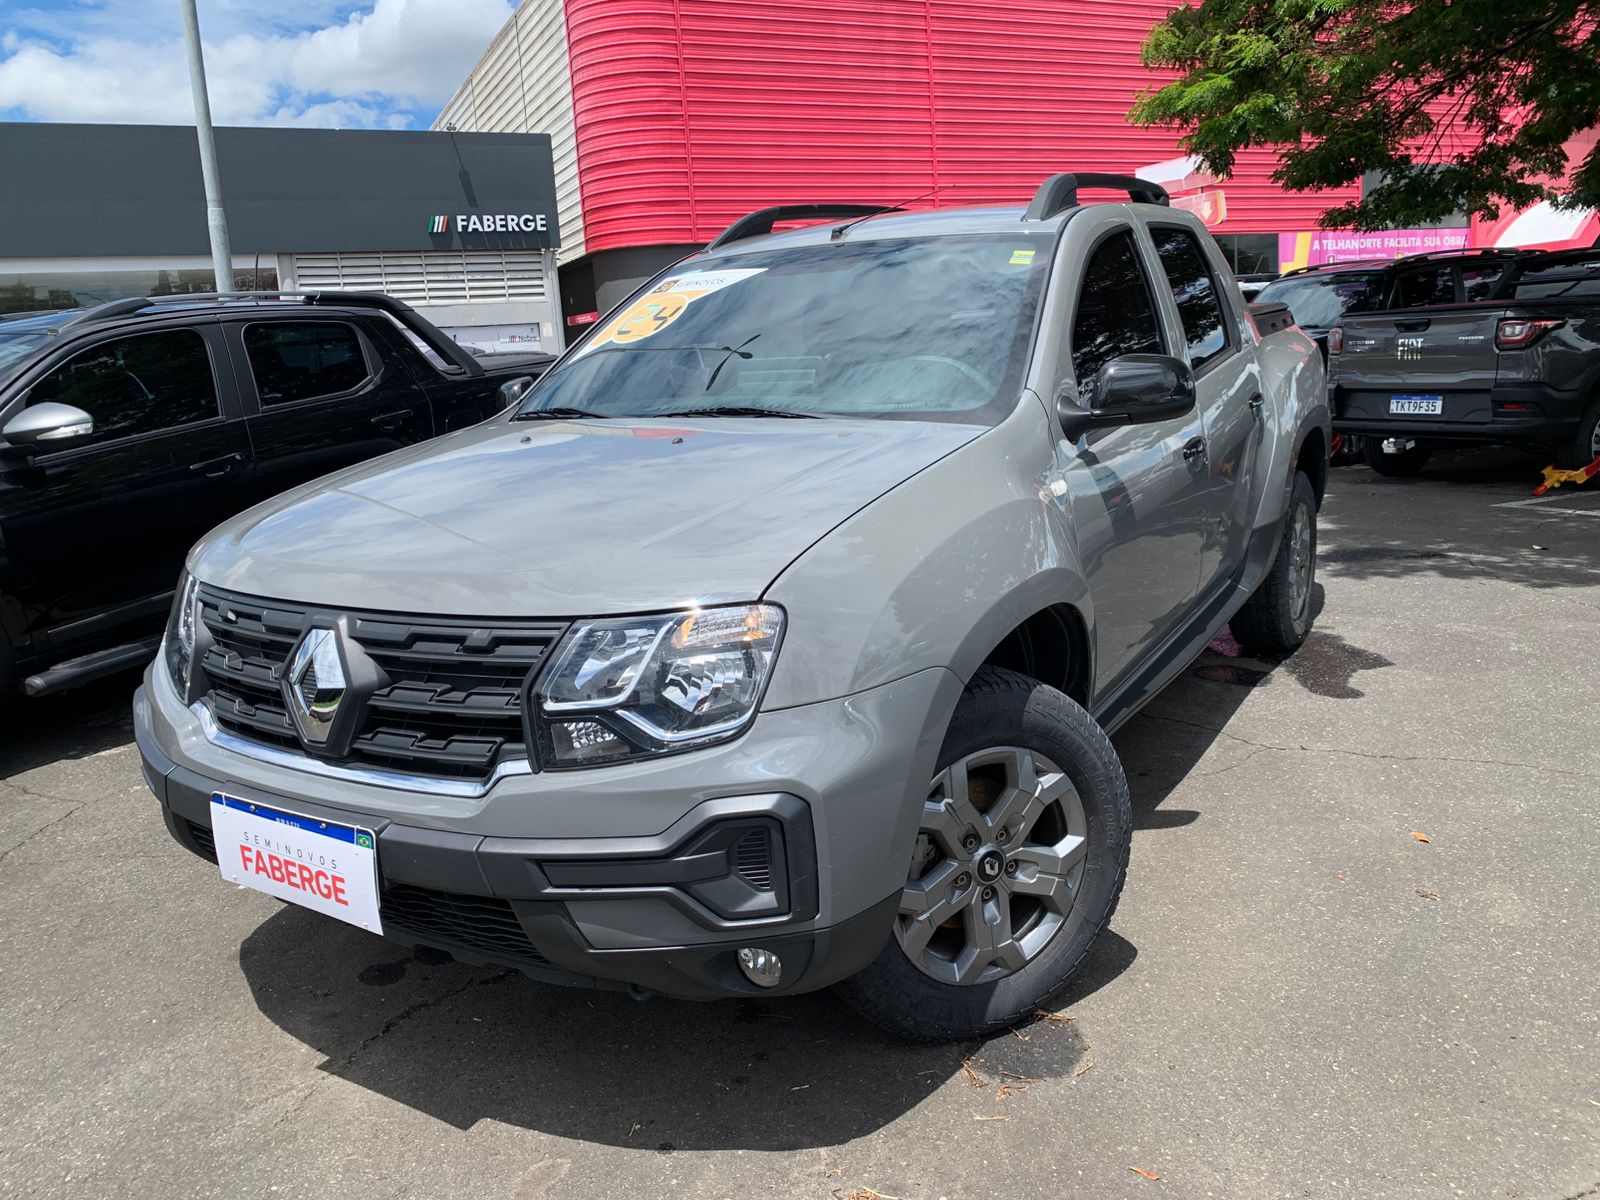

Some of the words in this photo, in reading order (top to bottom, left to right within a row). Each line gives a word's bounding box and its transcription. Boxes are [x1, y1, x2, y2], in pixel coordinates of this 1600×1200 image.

[456, 214, 547, 232] FABERGE
[1313, 240, 1320, 250] A
[1322, 238, 1382, 250] TELHANORTE
[1384, 236, 1422, 248] FACILITA
[1424, 236, 1441, 247] SUA
[1443, 235, 1468, 246] OBRA
[1398, 338, 1424, 349] FIAT
[1395, 400, 1437, 412] TKT9F35
[243, 831, 337, 869] SEMINOVOS
[239, 844, 350, 907] FABERGE
